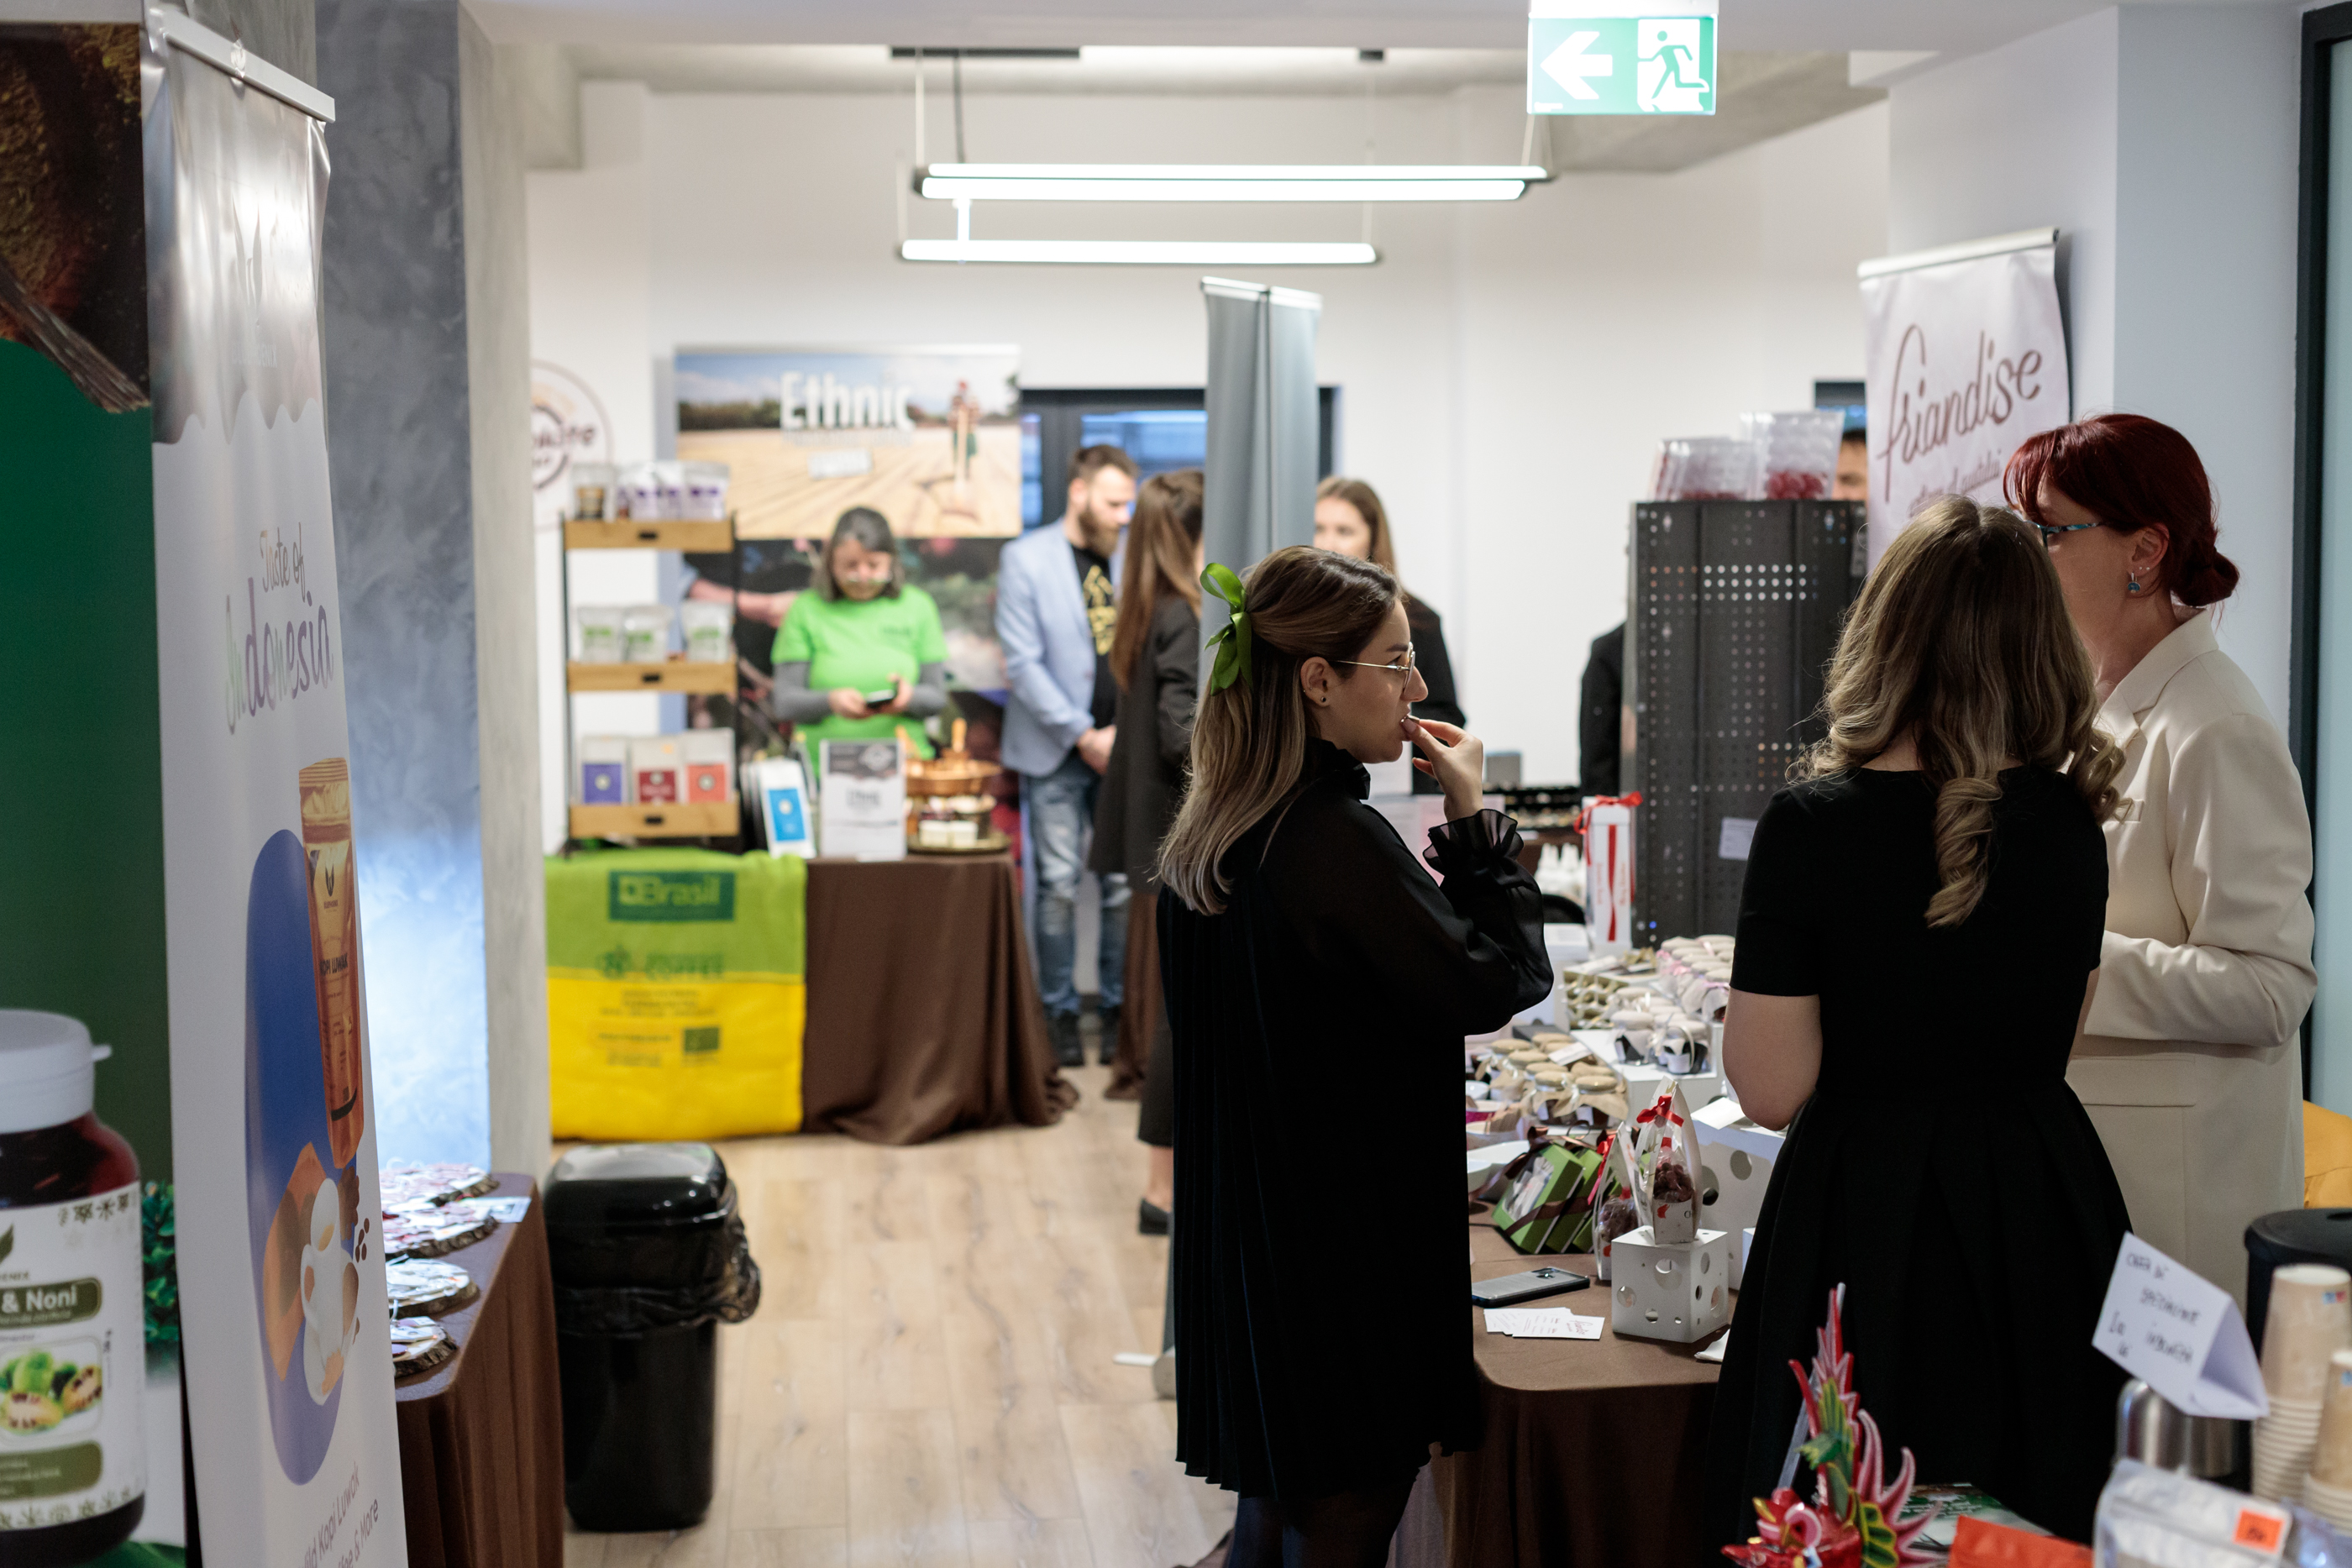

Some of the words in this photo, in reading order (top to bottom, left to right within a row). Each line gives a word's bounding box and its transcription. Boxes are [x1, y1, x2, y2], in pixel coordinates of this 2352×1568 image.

[780, 371, 916, 432] Ethnic
[260, 527, 291, 593] Taste
[292, 522, 306, 603] of
[25, 1284, 77, 1312] Noni
[318, 1502, 337, 1560] Kopi
[337, 1460, 360, 1526] Luwak
[360, 1499, 378, 1549] More
